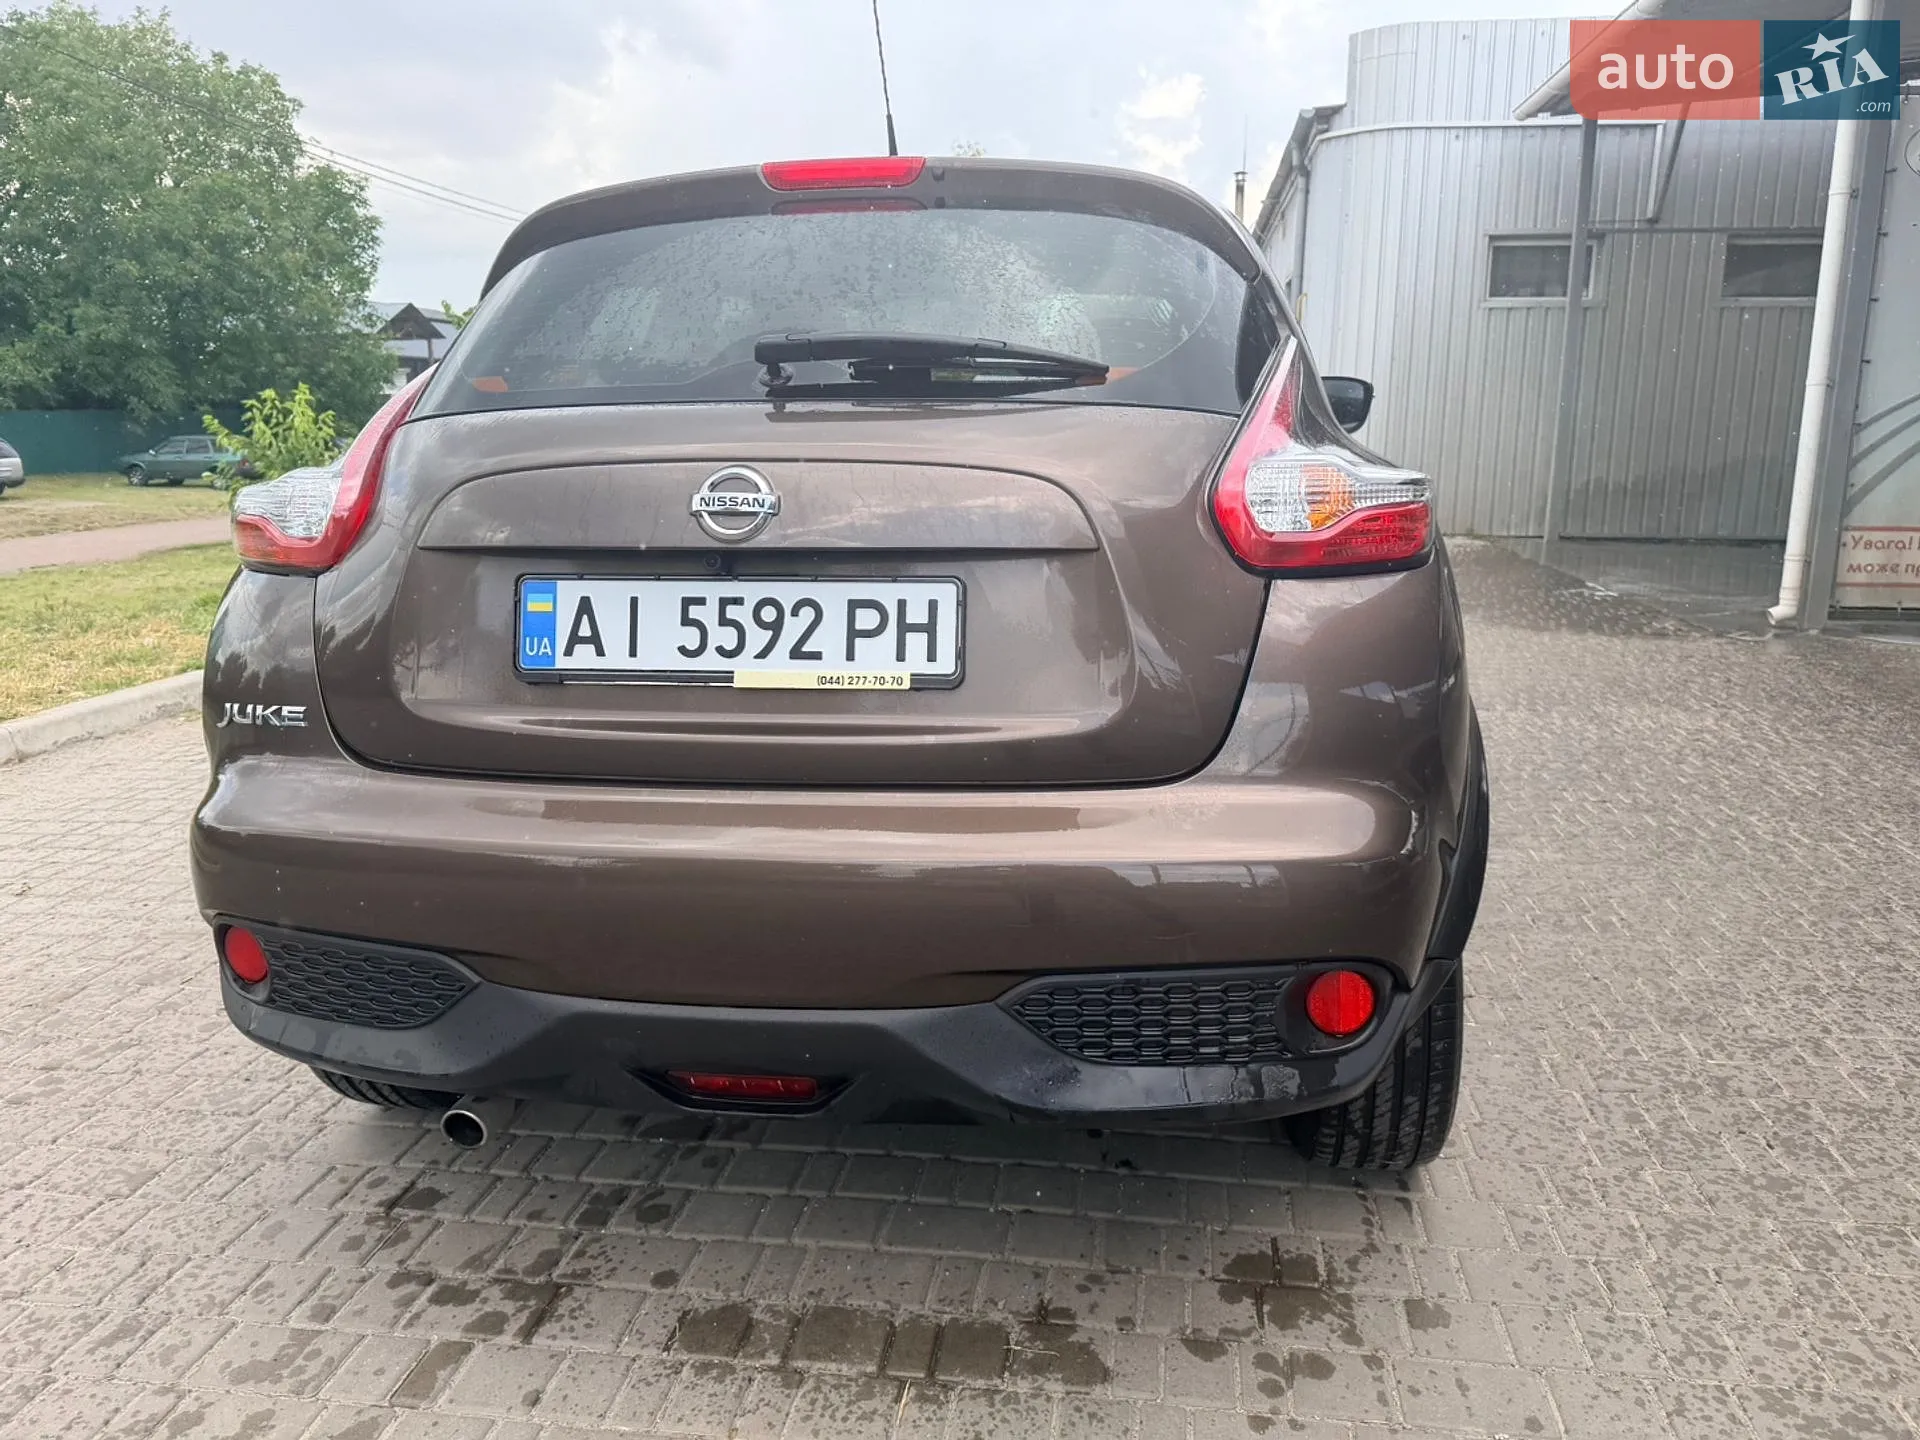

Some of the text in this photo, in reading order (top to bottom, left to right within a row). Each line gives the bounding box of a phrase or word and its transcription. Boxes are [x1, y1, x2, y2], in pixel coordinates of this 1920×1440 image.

[699, 496, 766, 508] NISSAN
[1851, 534, 1913, 550] Увага!
[1846, 563, 1900, 574] може
[562, 595, 938, 662] AI 5592 PH
[525, 637, 552, 656] UA
[817, 675, 904, 686] (044) 277-70-70
[216, 702, 307, 728] JUKE
